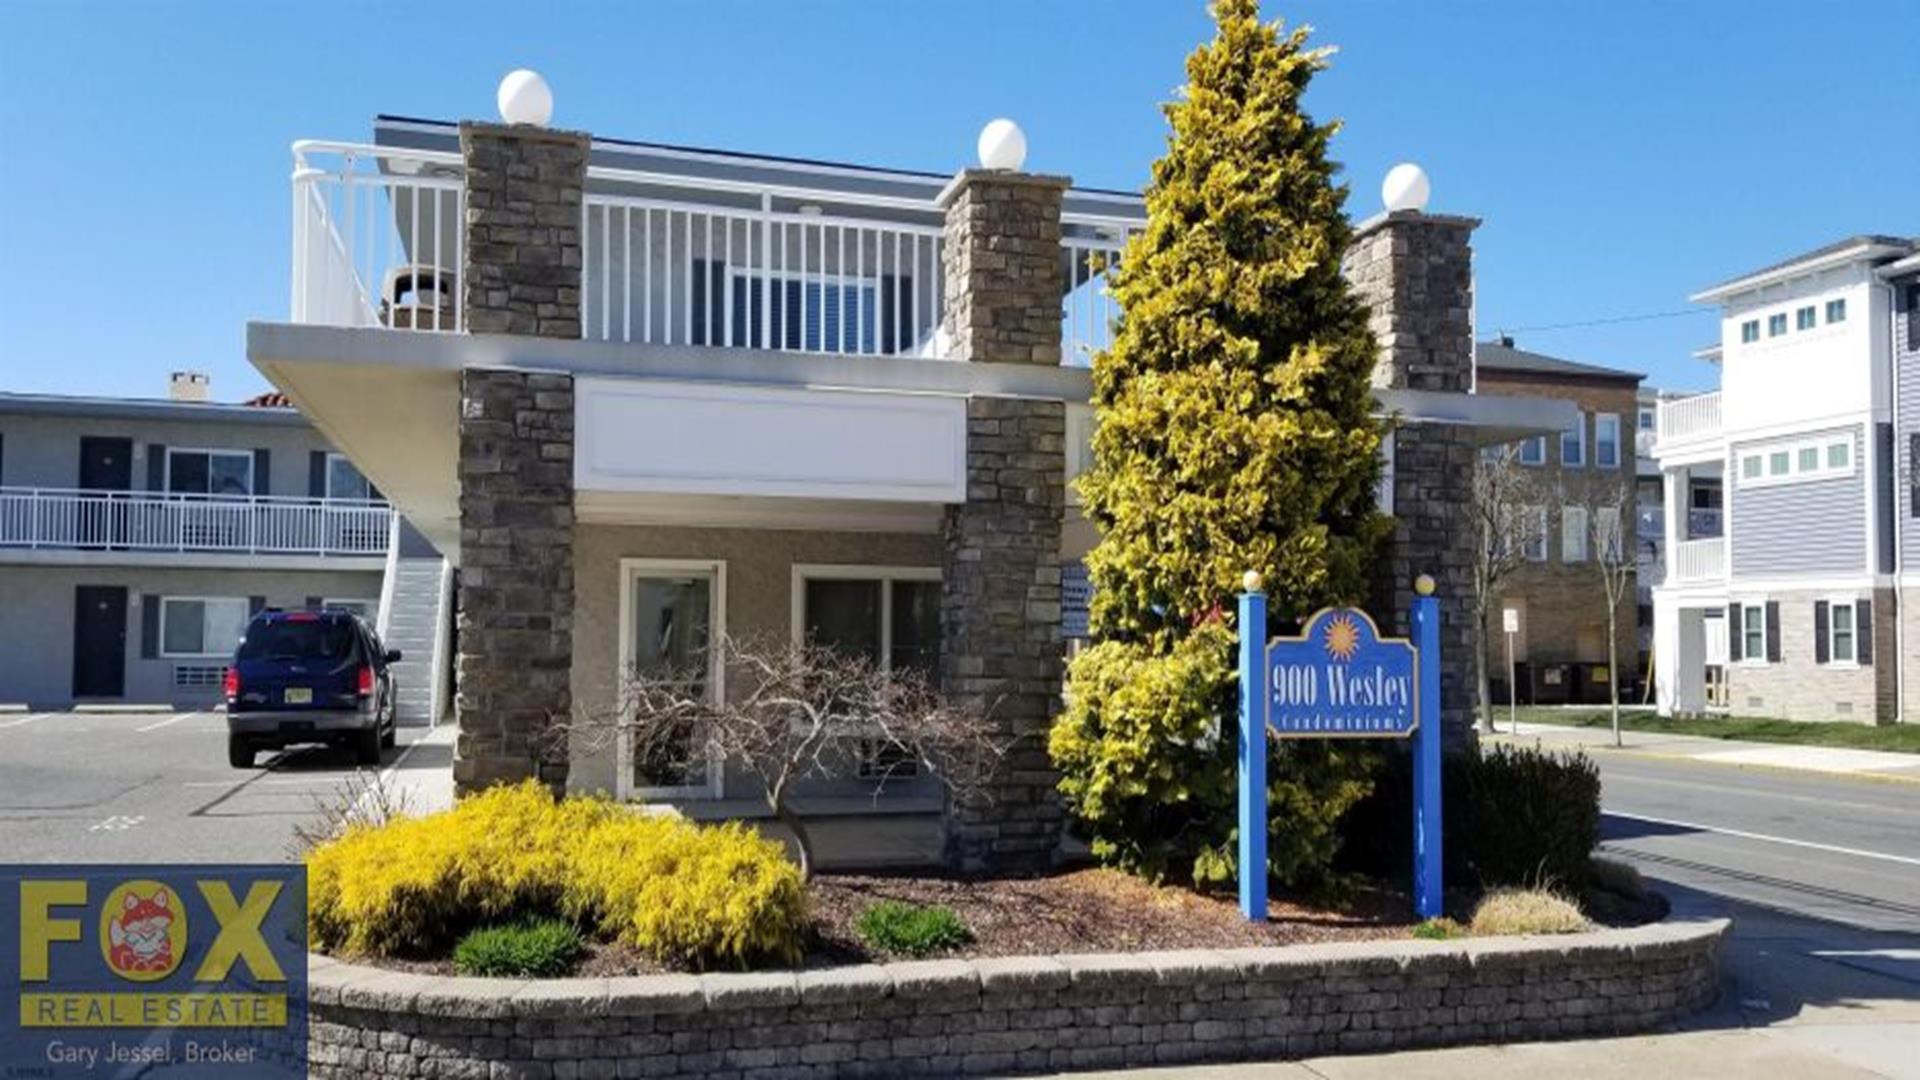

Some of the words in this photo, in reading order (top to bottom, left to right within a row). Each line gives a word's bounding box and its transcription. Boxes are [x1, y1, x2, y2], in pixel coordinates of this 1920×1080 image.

[1273, 664, 1318, 706] 900
[1326, 664, 1411, 715] Wesley
[1281, 713, 1403, 730] Condominiums
